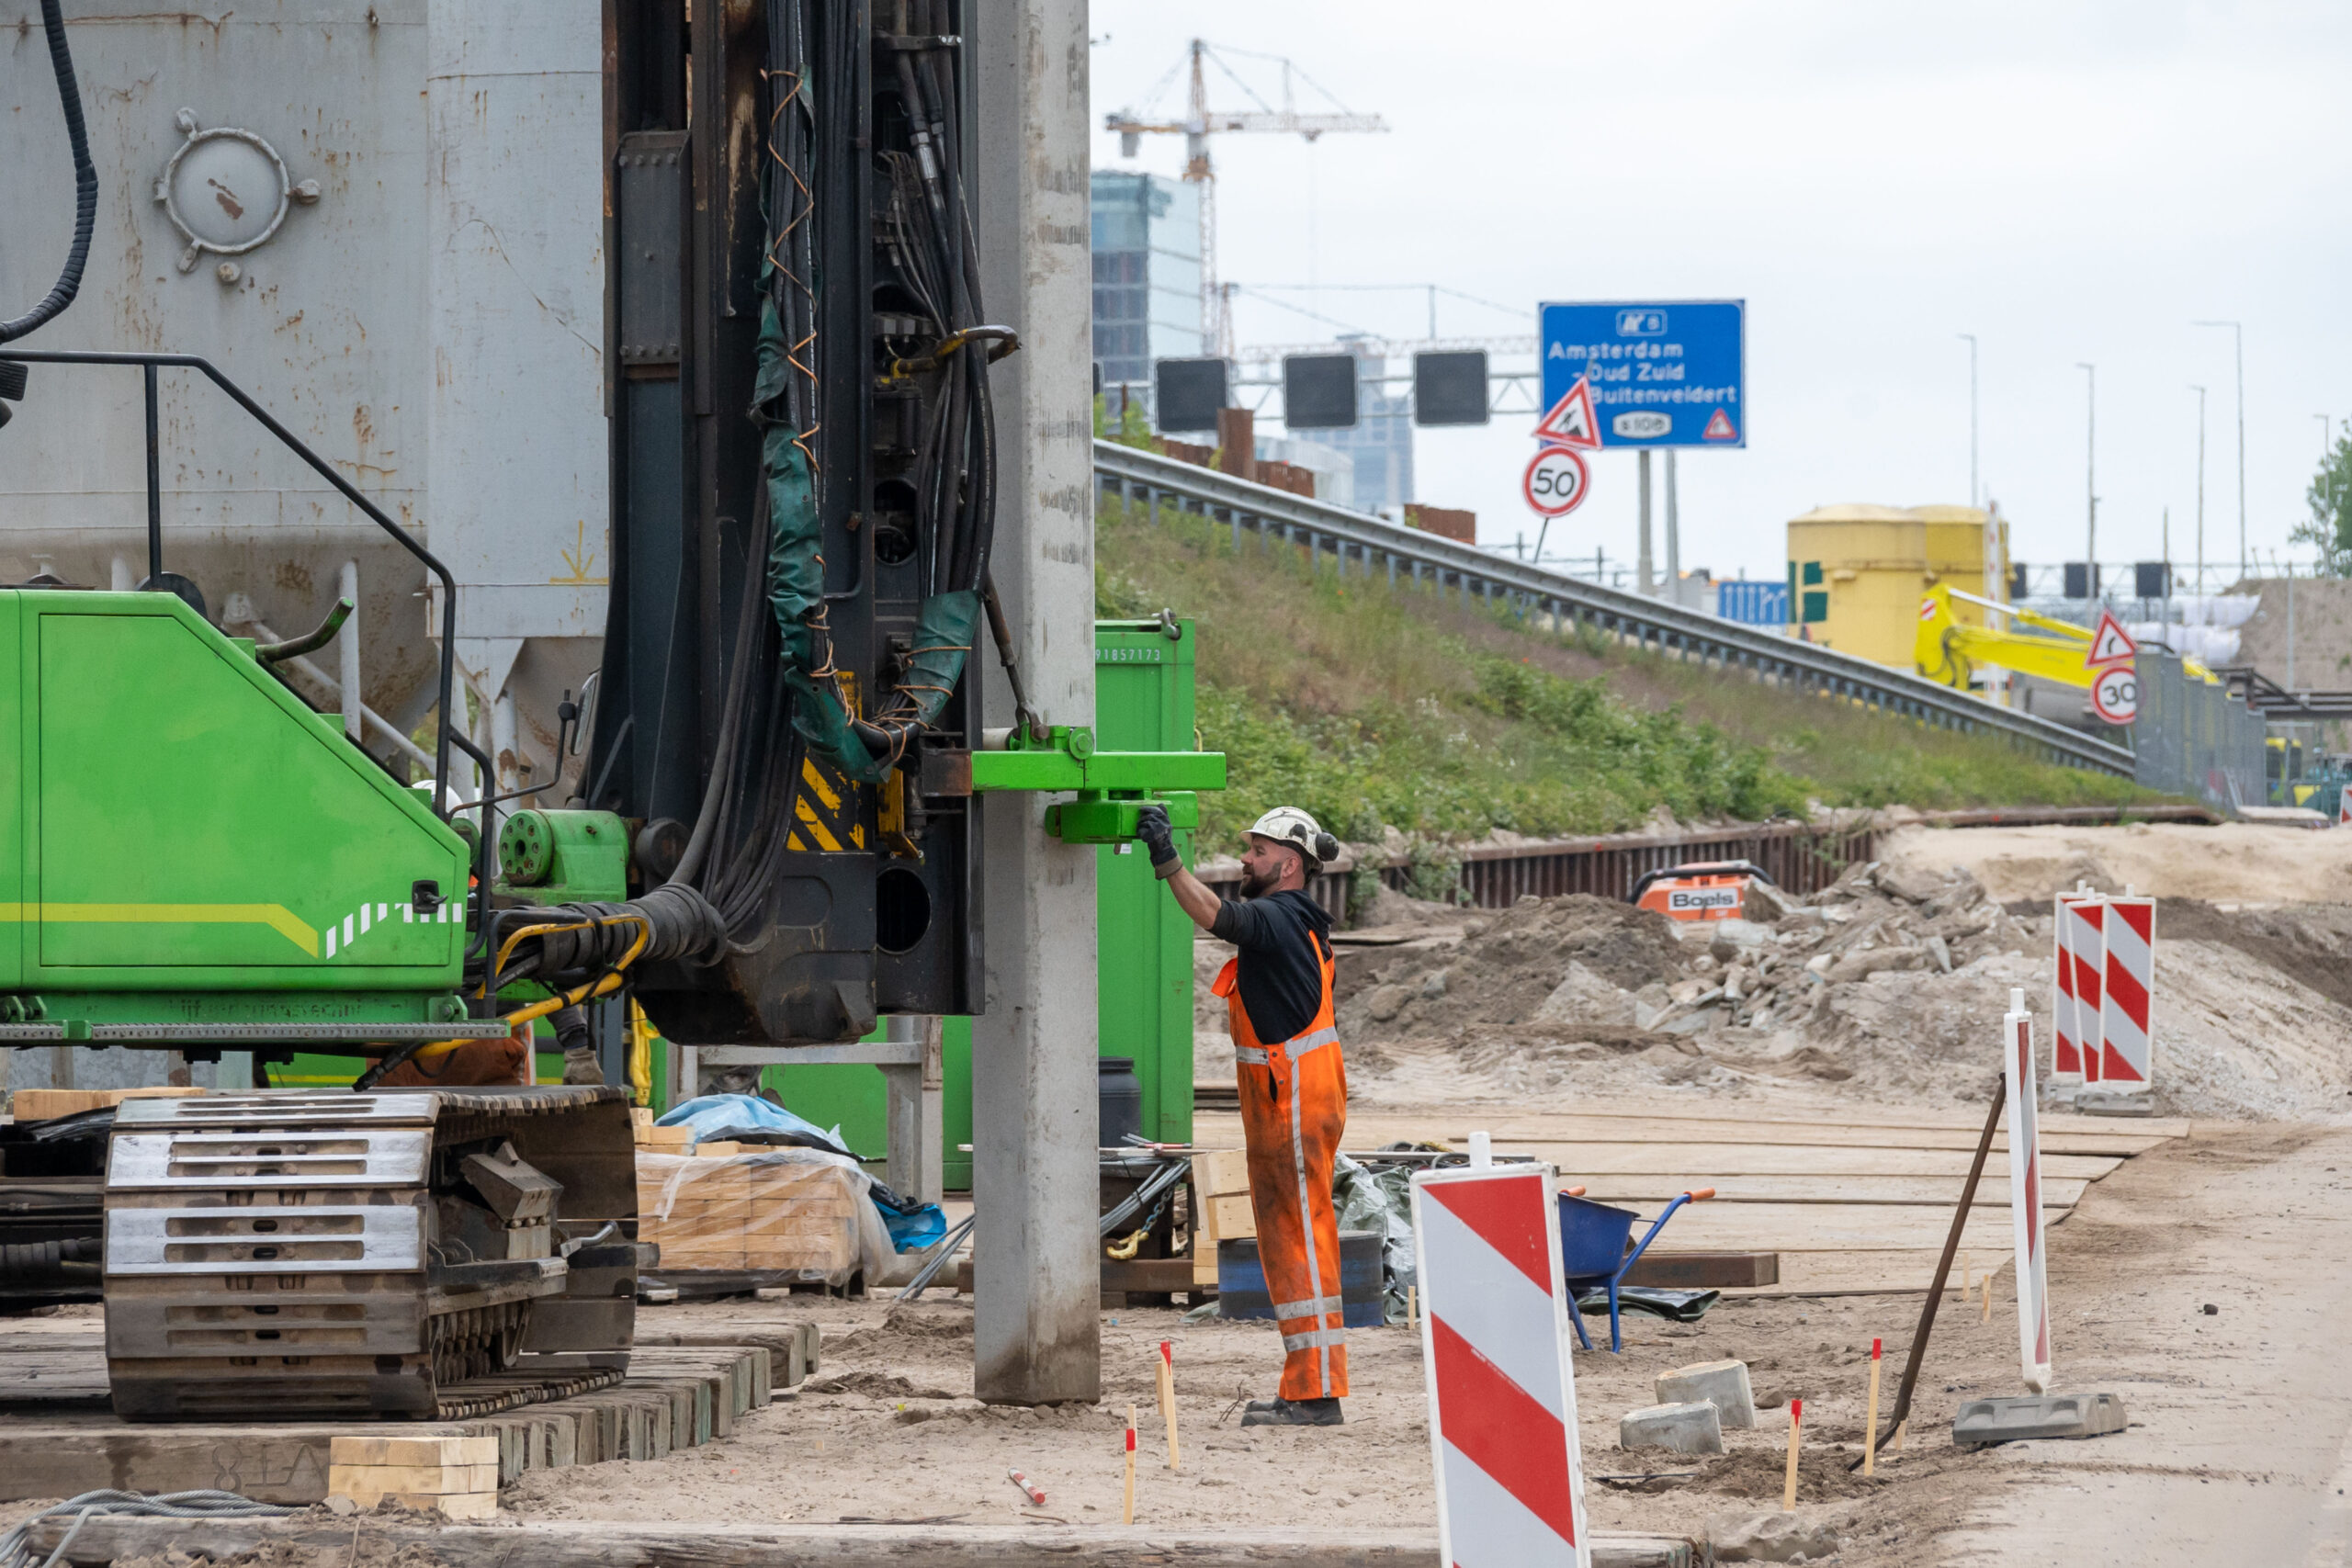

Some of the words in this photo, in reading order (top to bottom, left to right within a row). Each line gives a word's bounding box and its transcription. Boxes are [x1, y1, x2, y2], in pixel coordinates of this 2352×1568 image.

[1548, 341, 1683, 360] Amsterdam
[1589, 363, 1630, 381] Oud
[1636, 363, 1685, 381] Zuid
[1591, 385, 1736, 404] Buitenveldert
[1533, 468, 1576, 497] 50
[2103, 682, 2136, 706] 30
[1673, 892, 1734, 907] Boels
